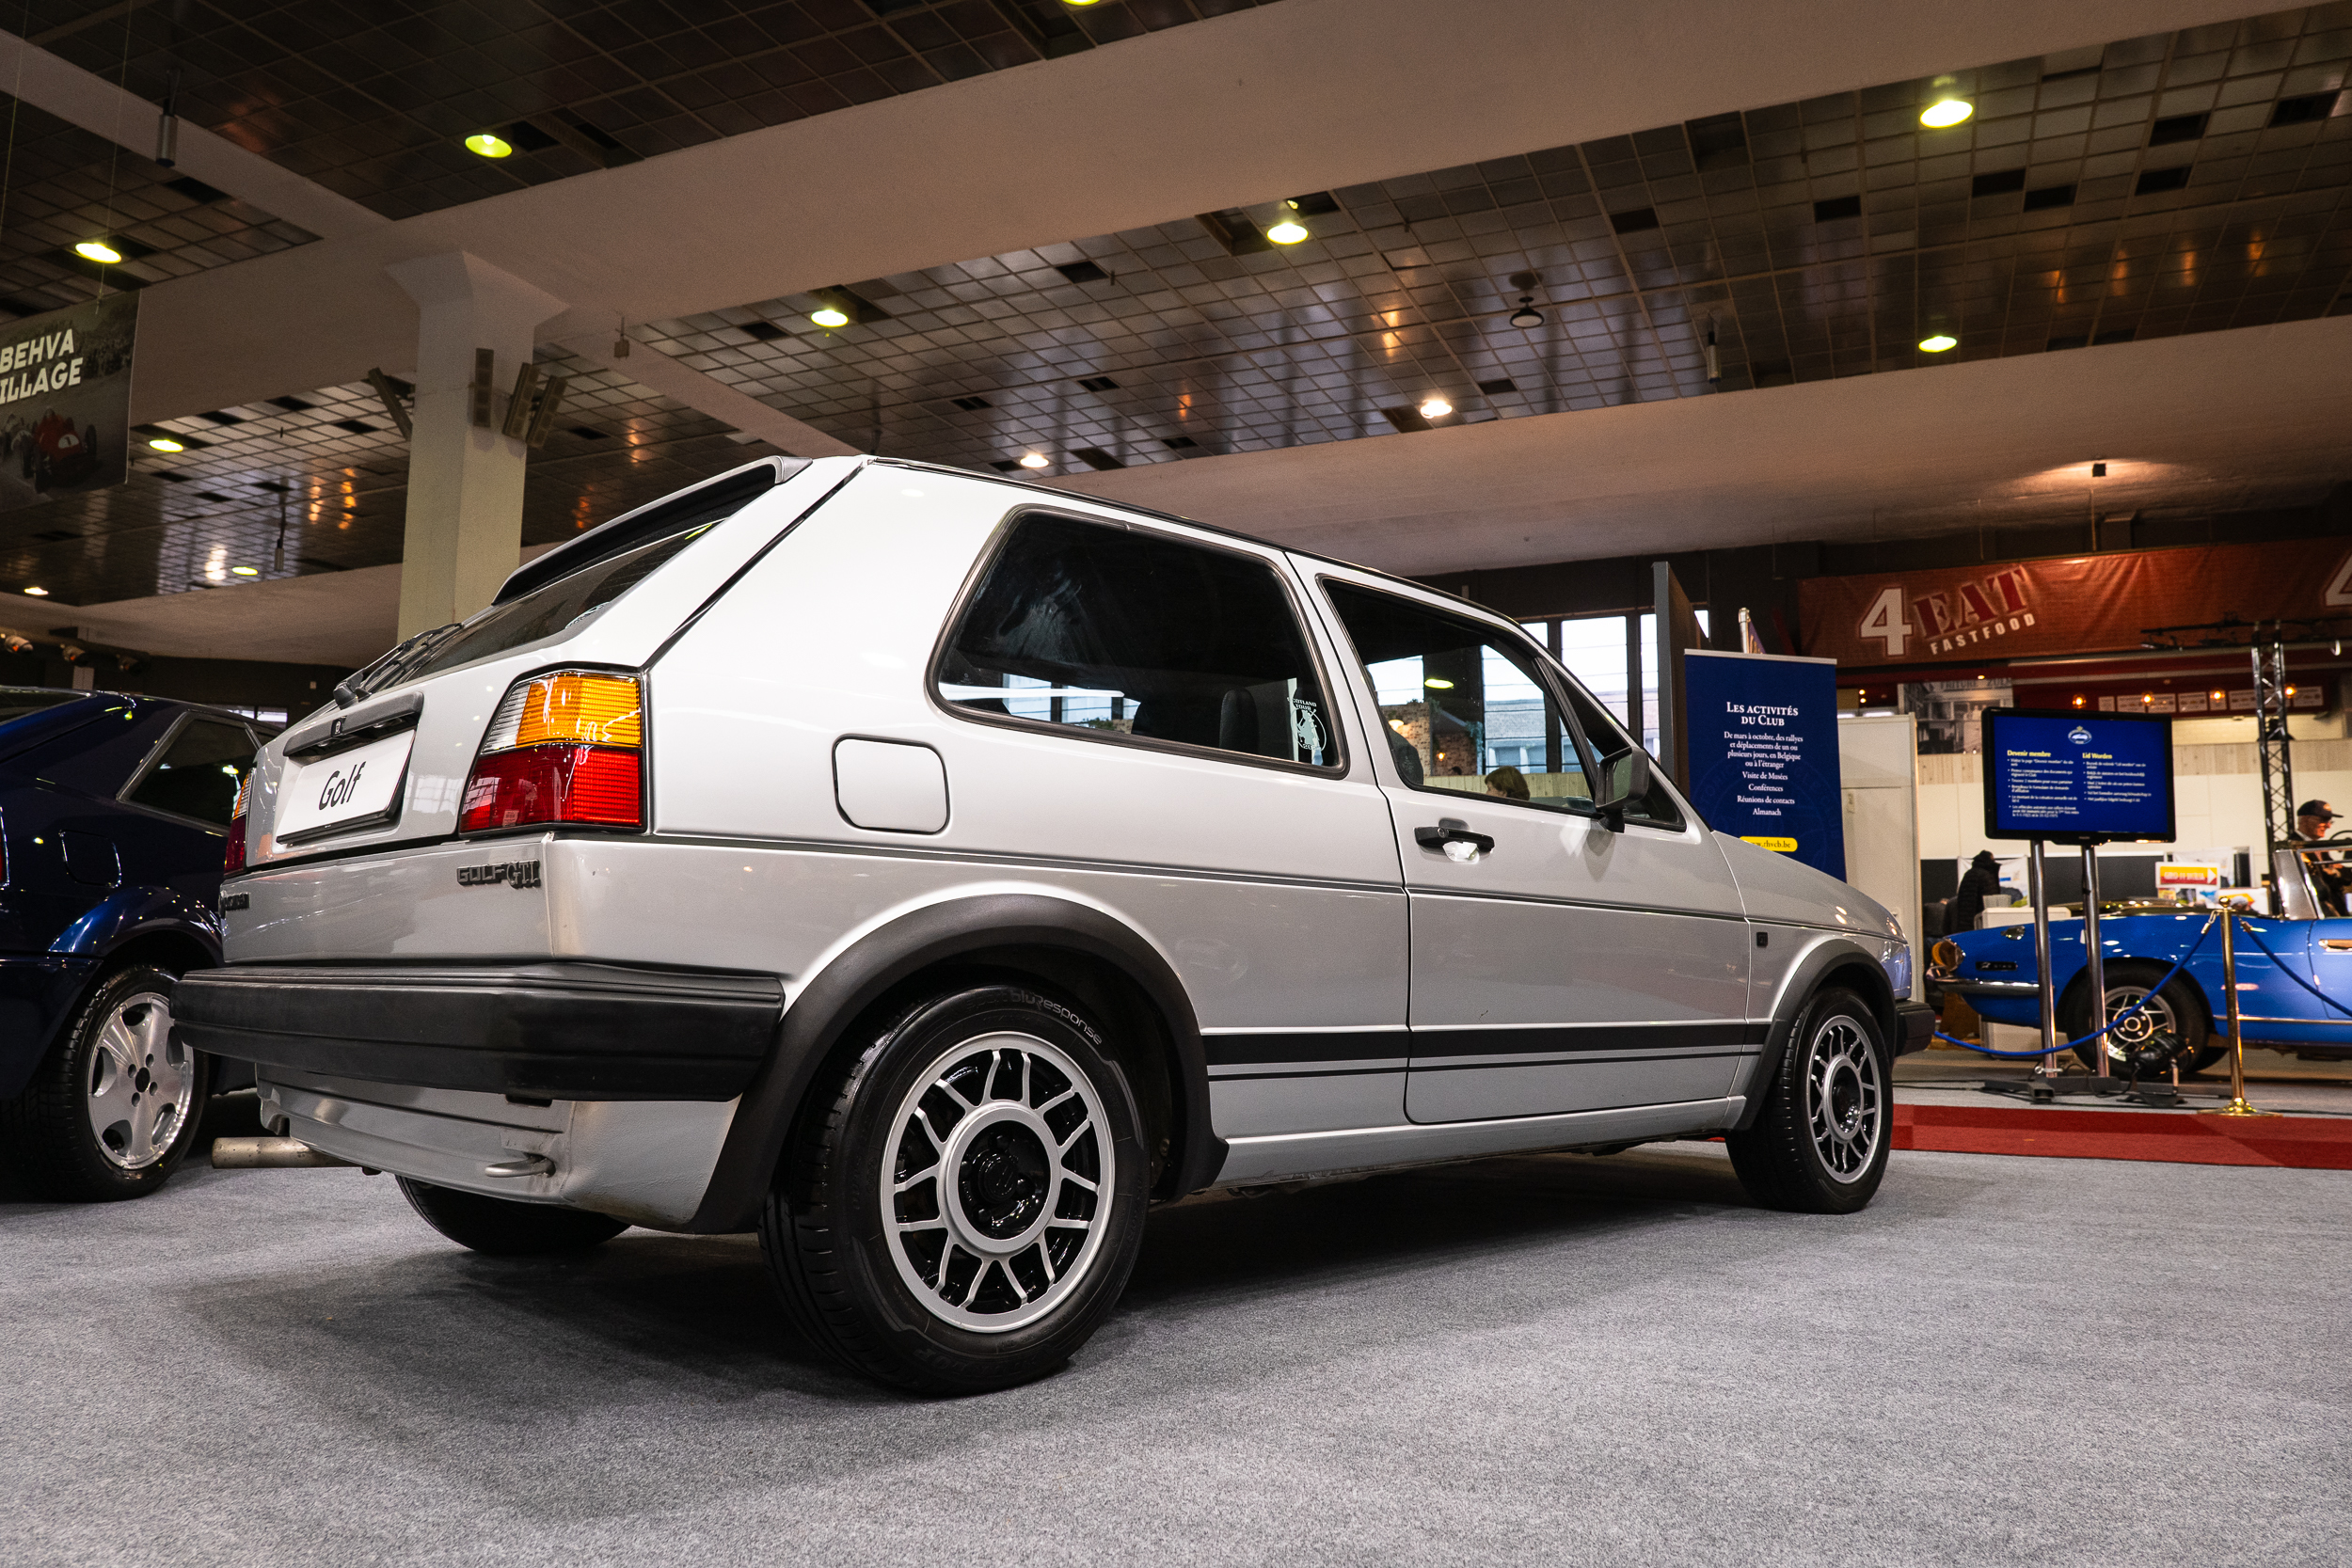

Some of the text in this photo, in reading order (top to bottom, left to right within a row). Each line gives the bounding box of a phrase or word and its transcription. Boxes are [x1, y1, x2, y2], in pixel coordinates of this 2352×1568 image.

[0, 328, 74, 374] BEHVA
[0, 357, 84, 405] ILLAGE
[1860, 565, 2027, 656] 4 EAT
[1931, 612, 2036, 655] FASTFOOD
[1753, 733, 1775, 741] octobre,
[1786, 735, 1804, 744] rallyes
[1736, 740, 1773, 751] déplacements
[1727, 749, 1752, 758] plusieurs
[1753, 751, 1769, 759] jours,
[1777, 752, 1801, 762] Belgique
[1758, 760, 1785, 769] l'étranger
[1760, 771, 1767, 780] de
[1769, 772, 1788, 781] Musées
[319, 761, 366, 810] Golf
[1748, 783, 1784, 792] Conférences
[1737, 795, 1764, 803] Réunions
[1753, 807, 1782, 816] Almanach
[1752, 839, 1791, 848] w.rhvcb.be
[457, 859, 540, 885] GOLF GTI
